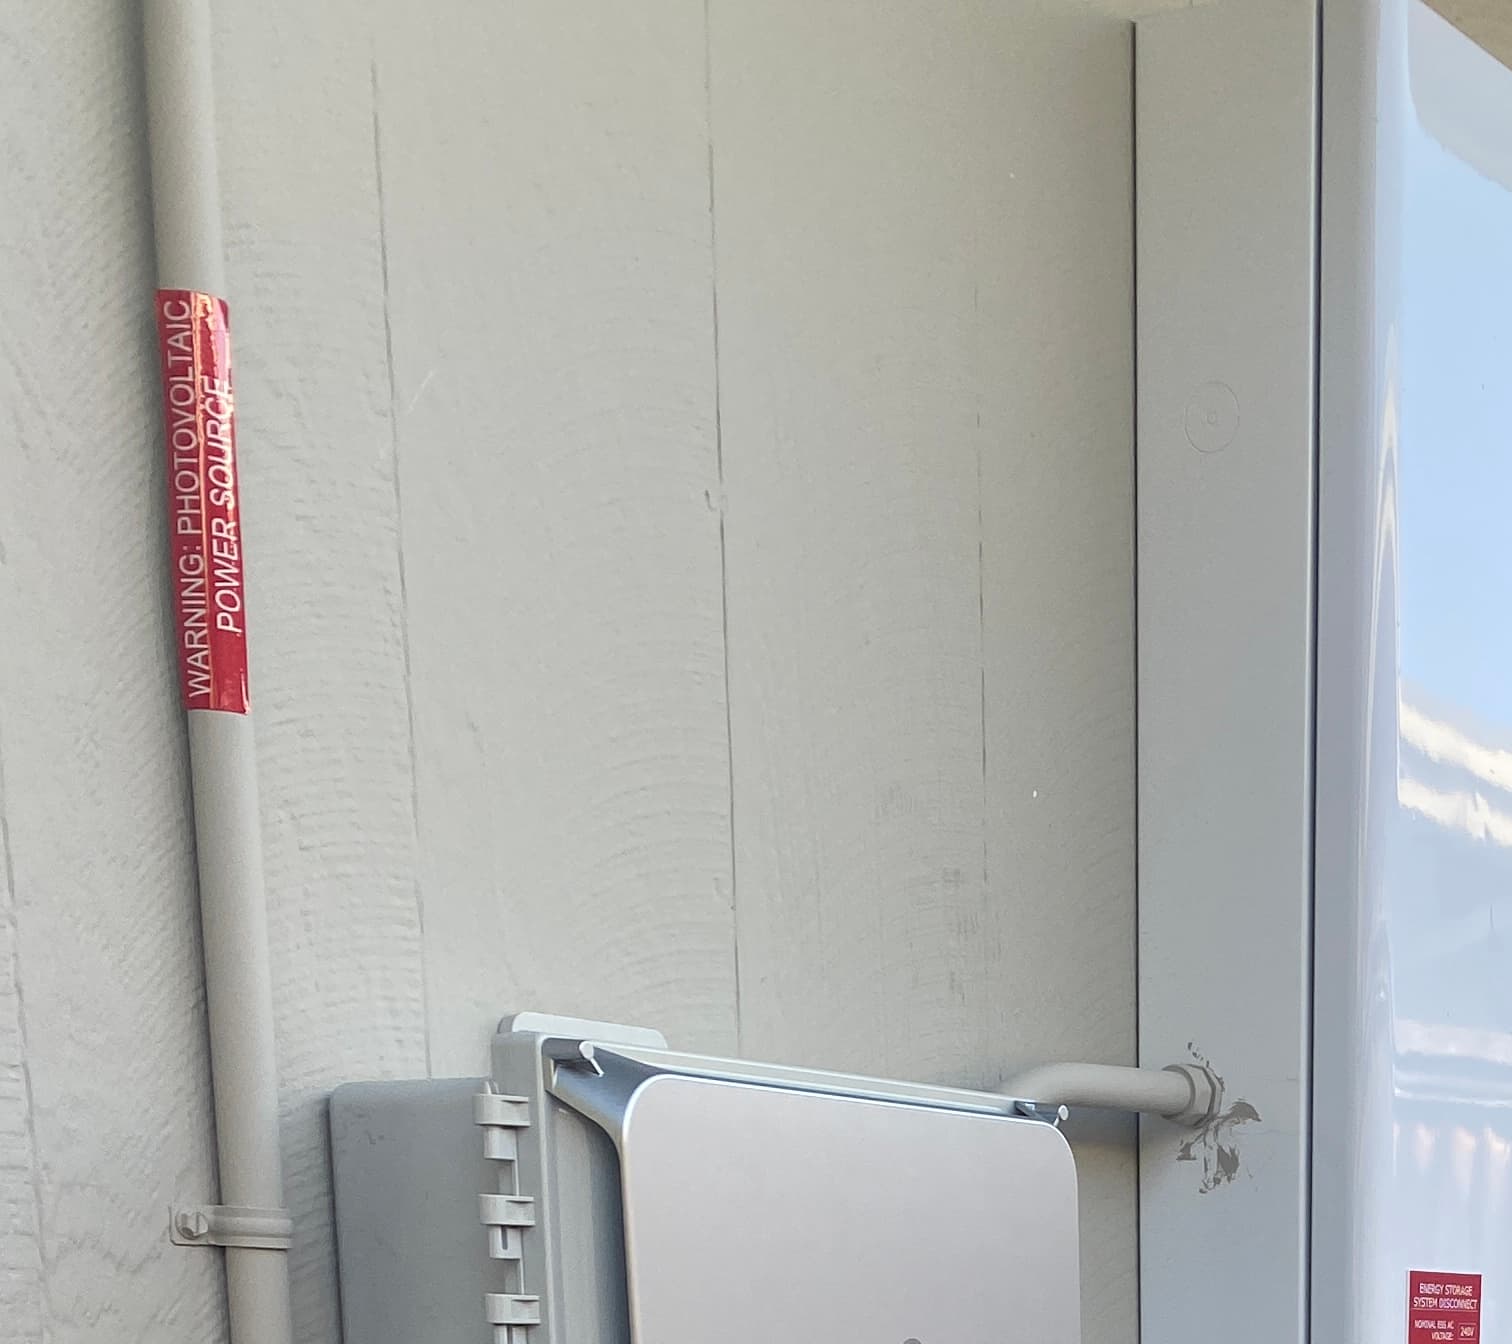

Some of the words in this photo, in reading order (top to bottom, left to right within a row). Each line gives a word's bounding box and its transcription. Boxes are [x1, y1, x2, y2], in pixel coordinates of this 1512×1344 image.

[165, 299, 203, 536] PHOTOVOLTAIC
[203, 379, 237, 508] SOURCE
[178, 545, 210, 698] WARNING:
[210, 517, 242, 634] POWER
[1413, 1297, 1438, 1309] SYSTEM
[1439, 1298, 1477, 1310] DISCONNECT
[1420, 1283, 1443, 1295] ENERGY
[1445, 1284, 1472, 1296] STORAGE
